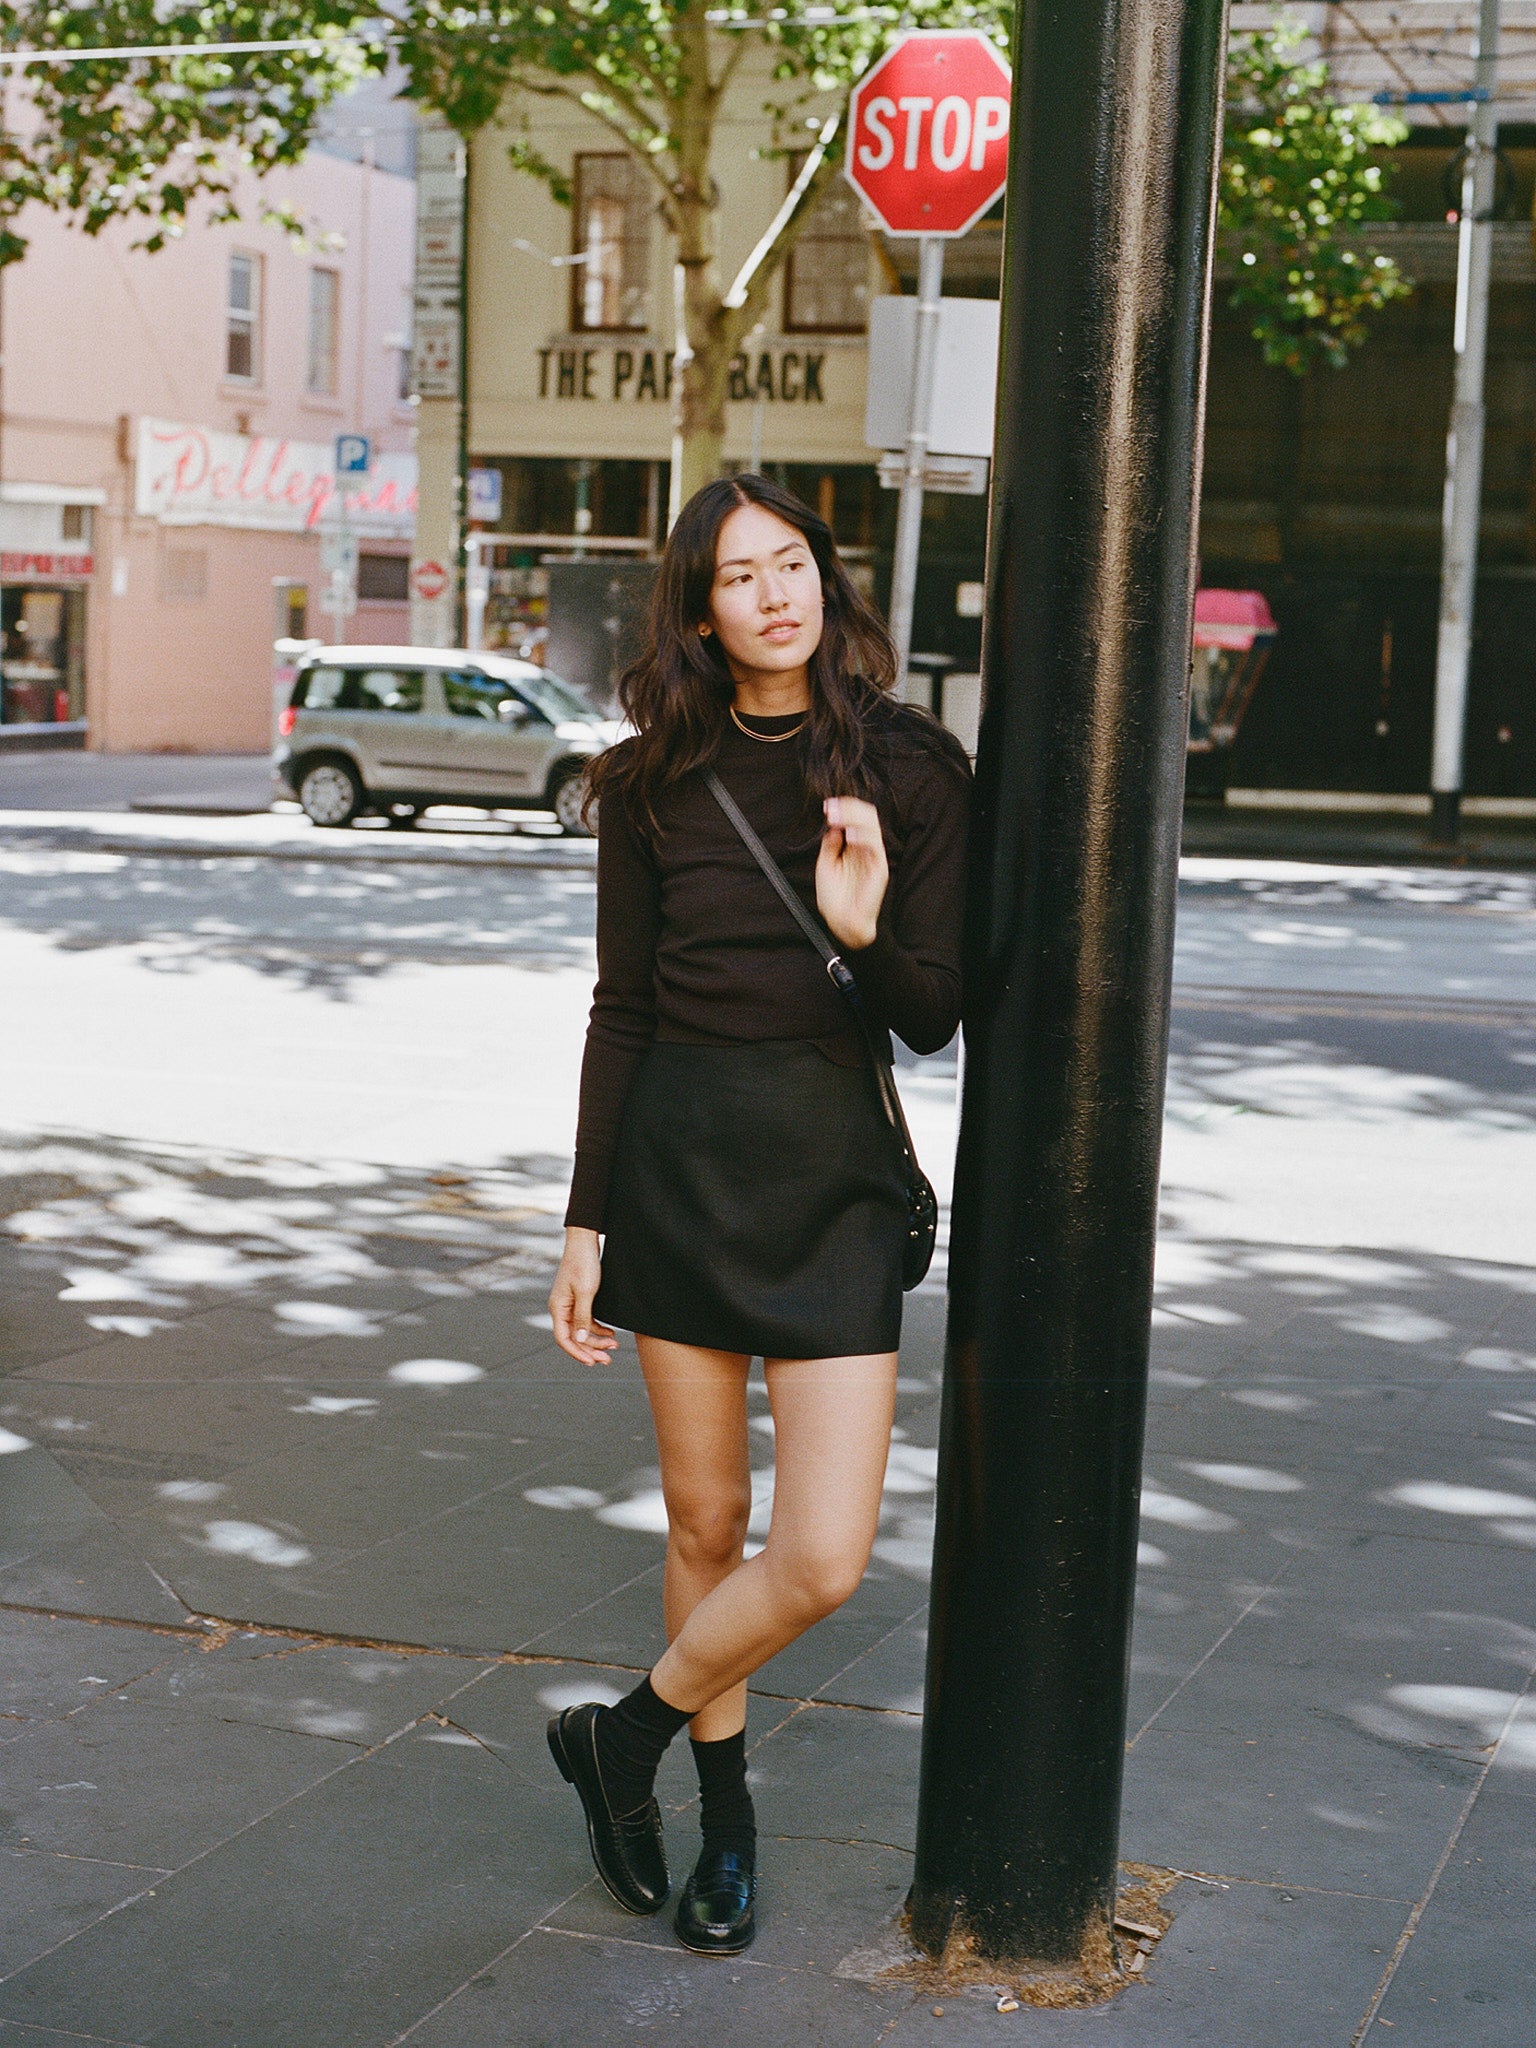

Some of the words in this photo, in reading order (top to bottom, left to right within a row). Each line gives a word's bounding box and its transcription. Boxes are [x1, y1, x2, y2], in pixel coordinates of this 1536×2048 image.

[858, 96, 1010, 172] STOP
[539, 350, 595, 398] THE
[613, 351, 824, 401] PAPBACK
[341, 440, 365, 470] P
